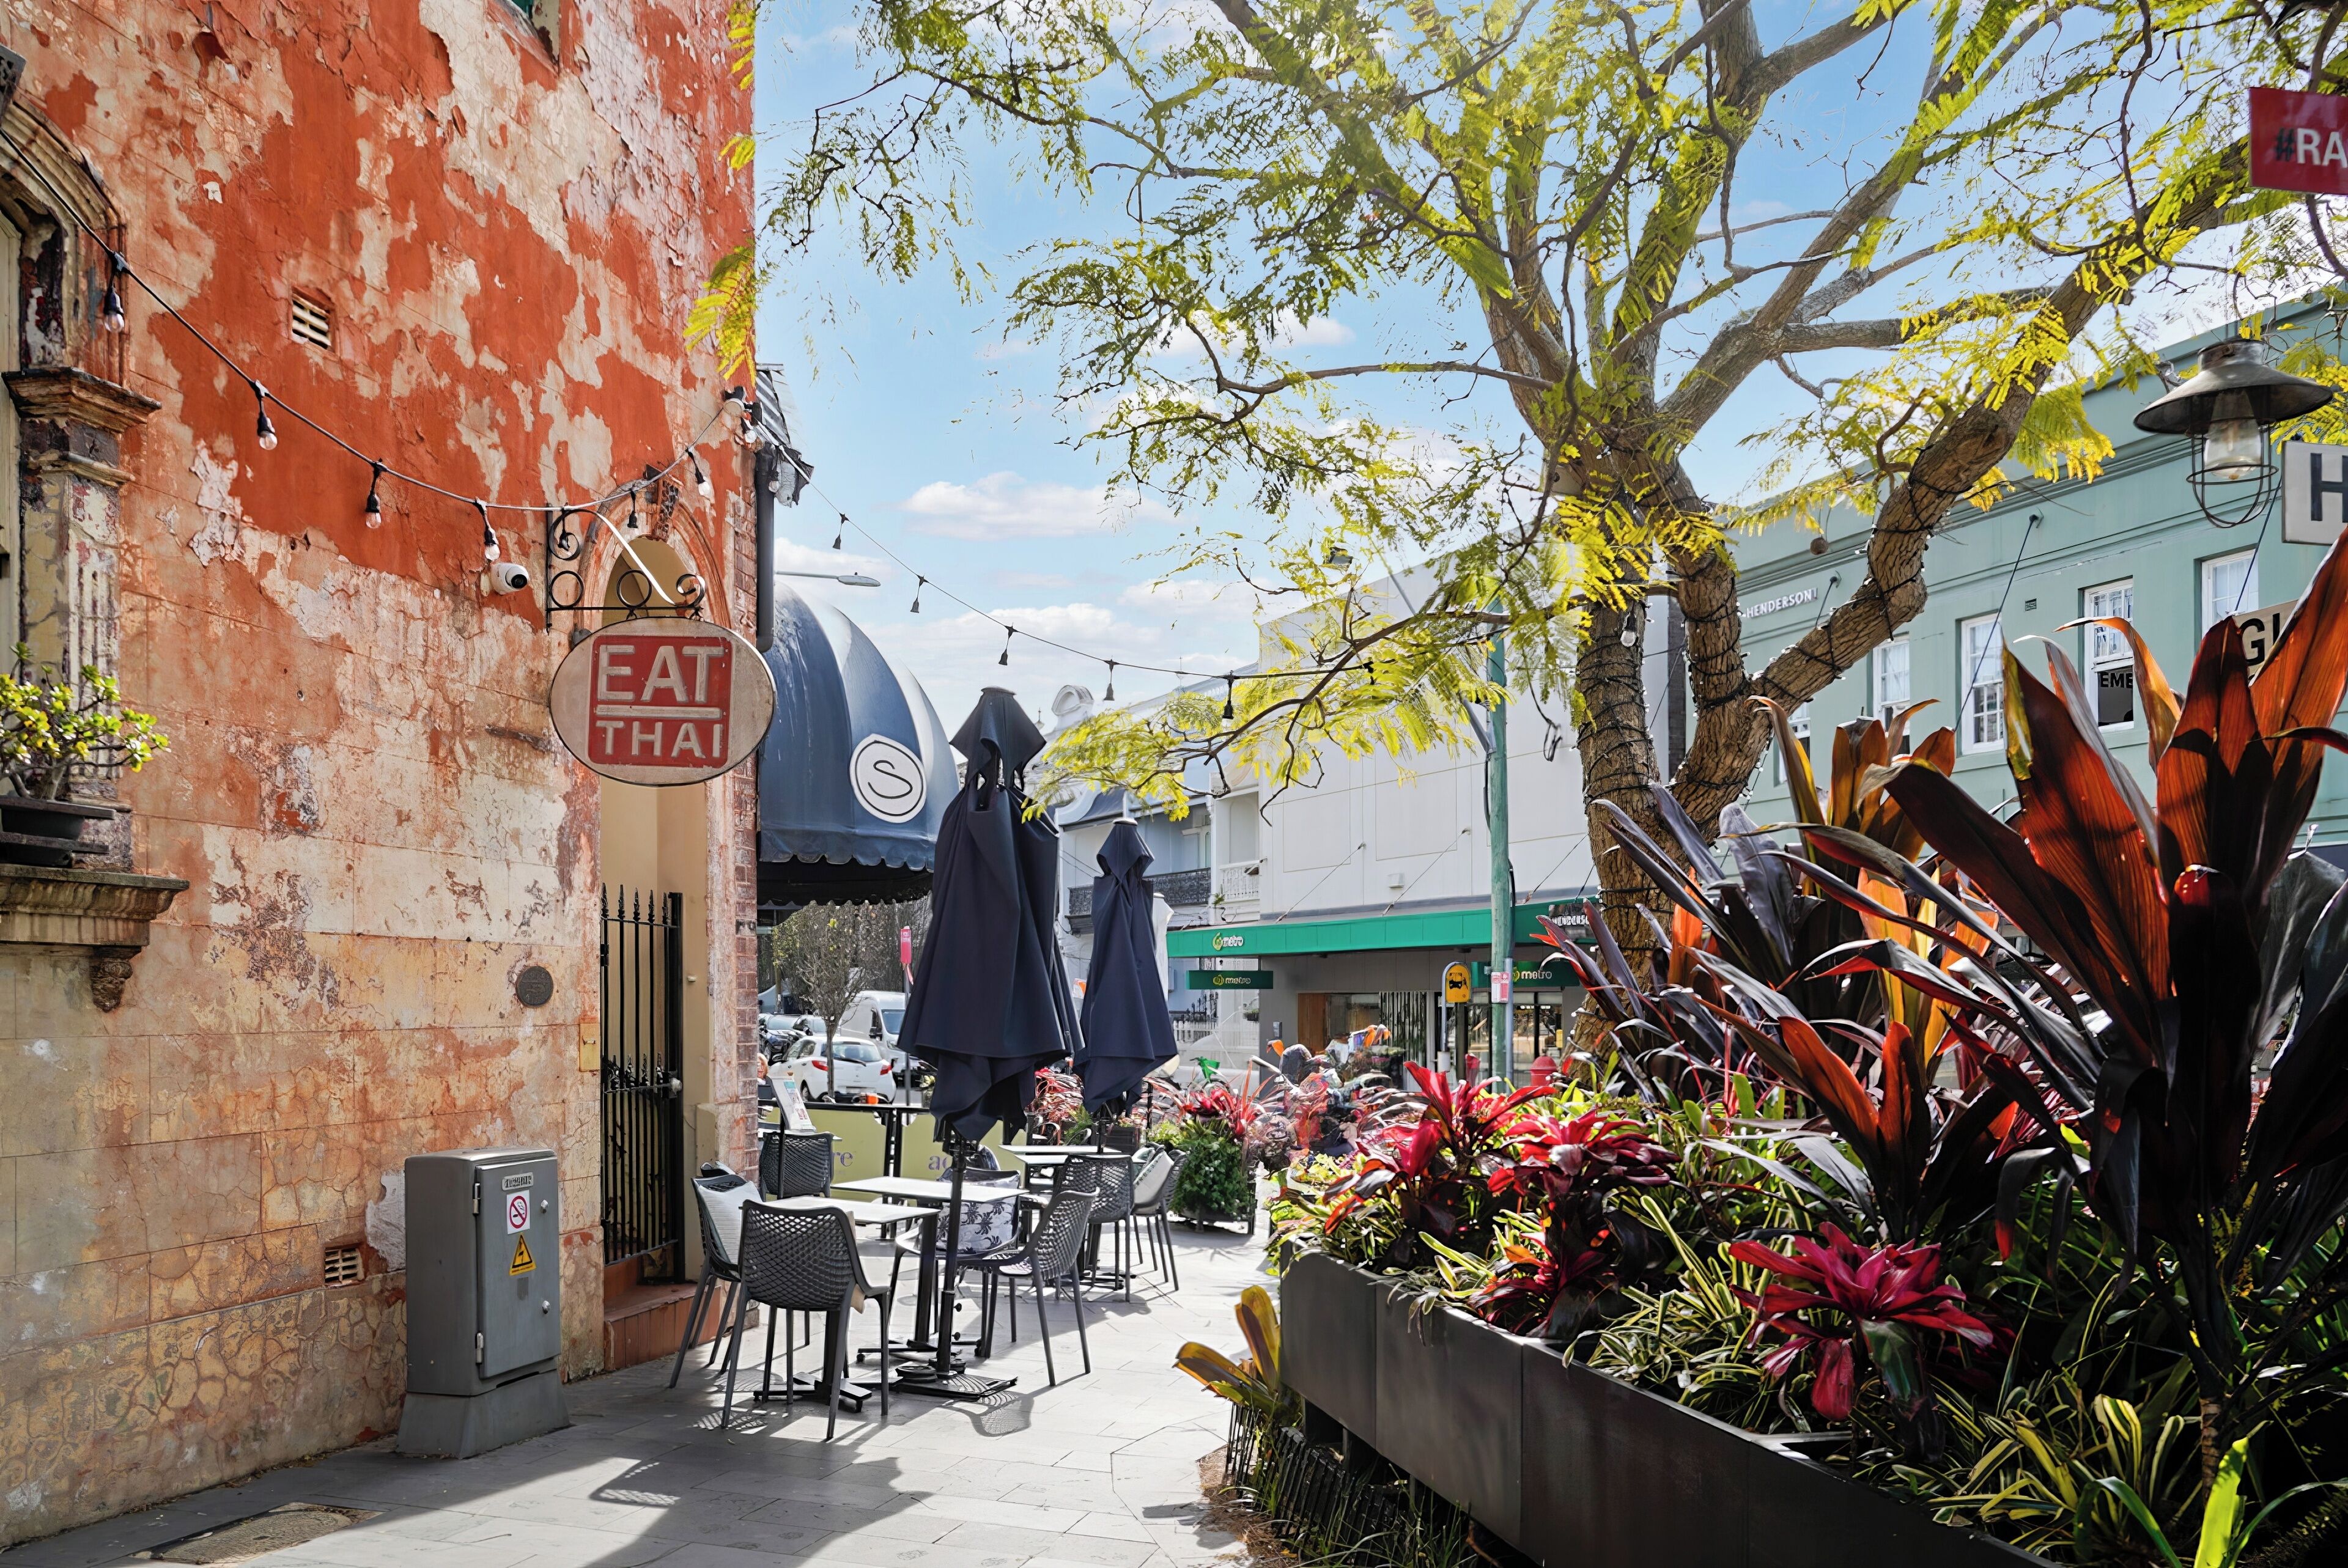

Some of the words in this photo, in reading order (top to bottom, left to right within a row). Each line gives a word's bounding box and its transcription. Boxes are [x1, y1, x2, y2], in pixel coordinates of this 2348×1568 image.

[2311, 453, 2348, 523] H
[596, 644, 729, 703] EAT
[596, 720, 723, 759] THAI
[868, 759, 913, 799] S
[1521, 970, 1552, 979] metro
